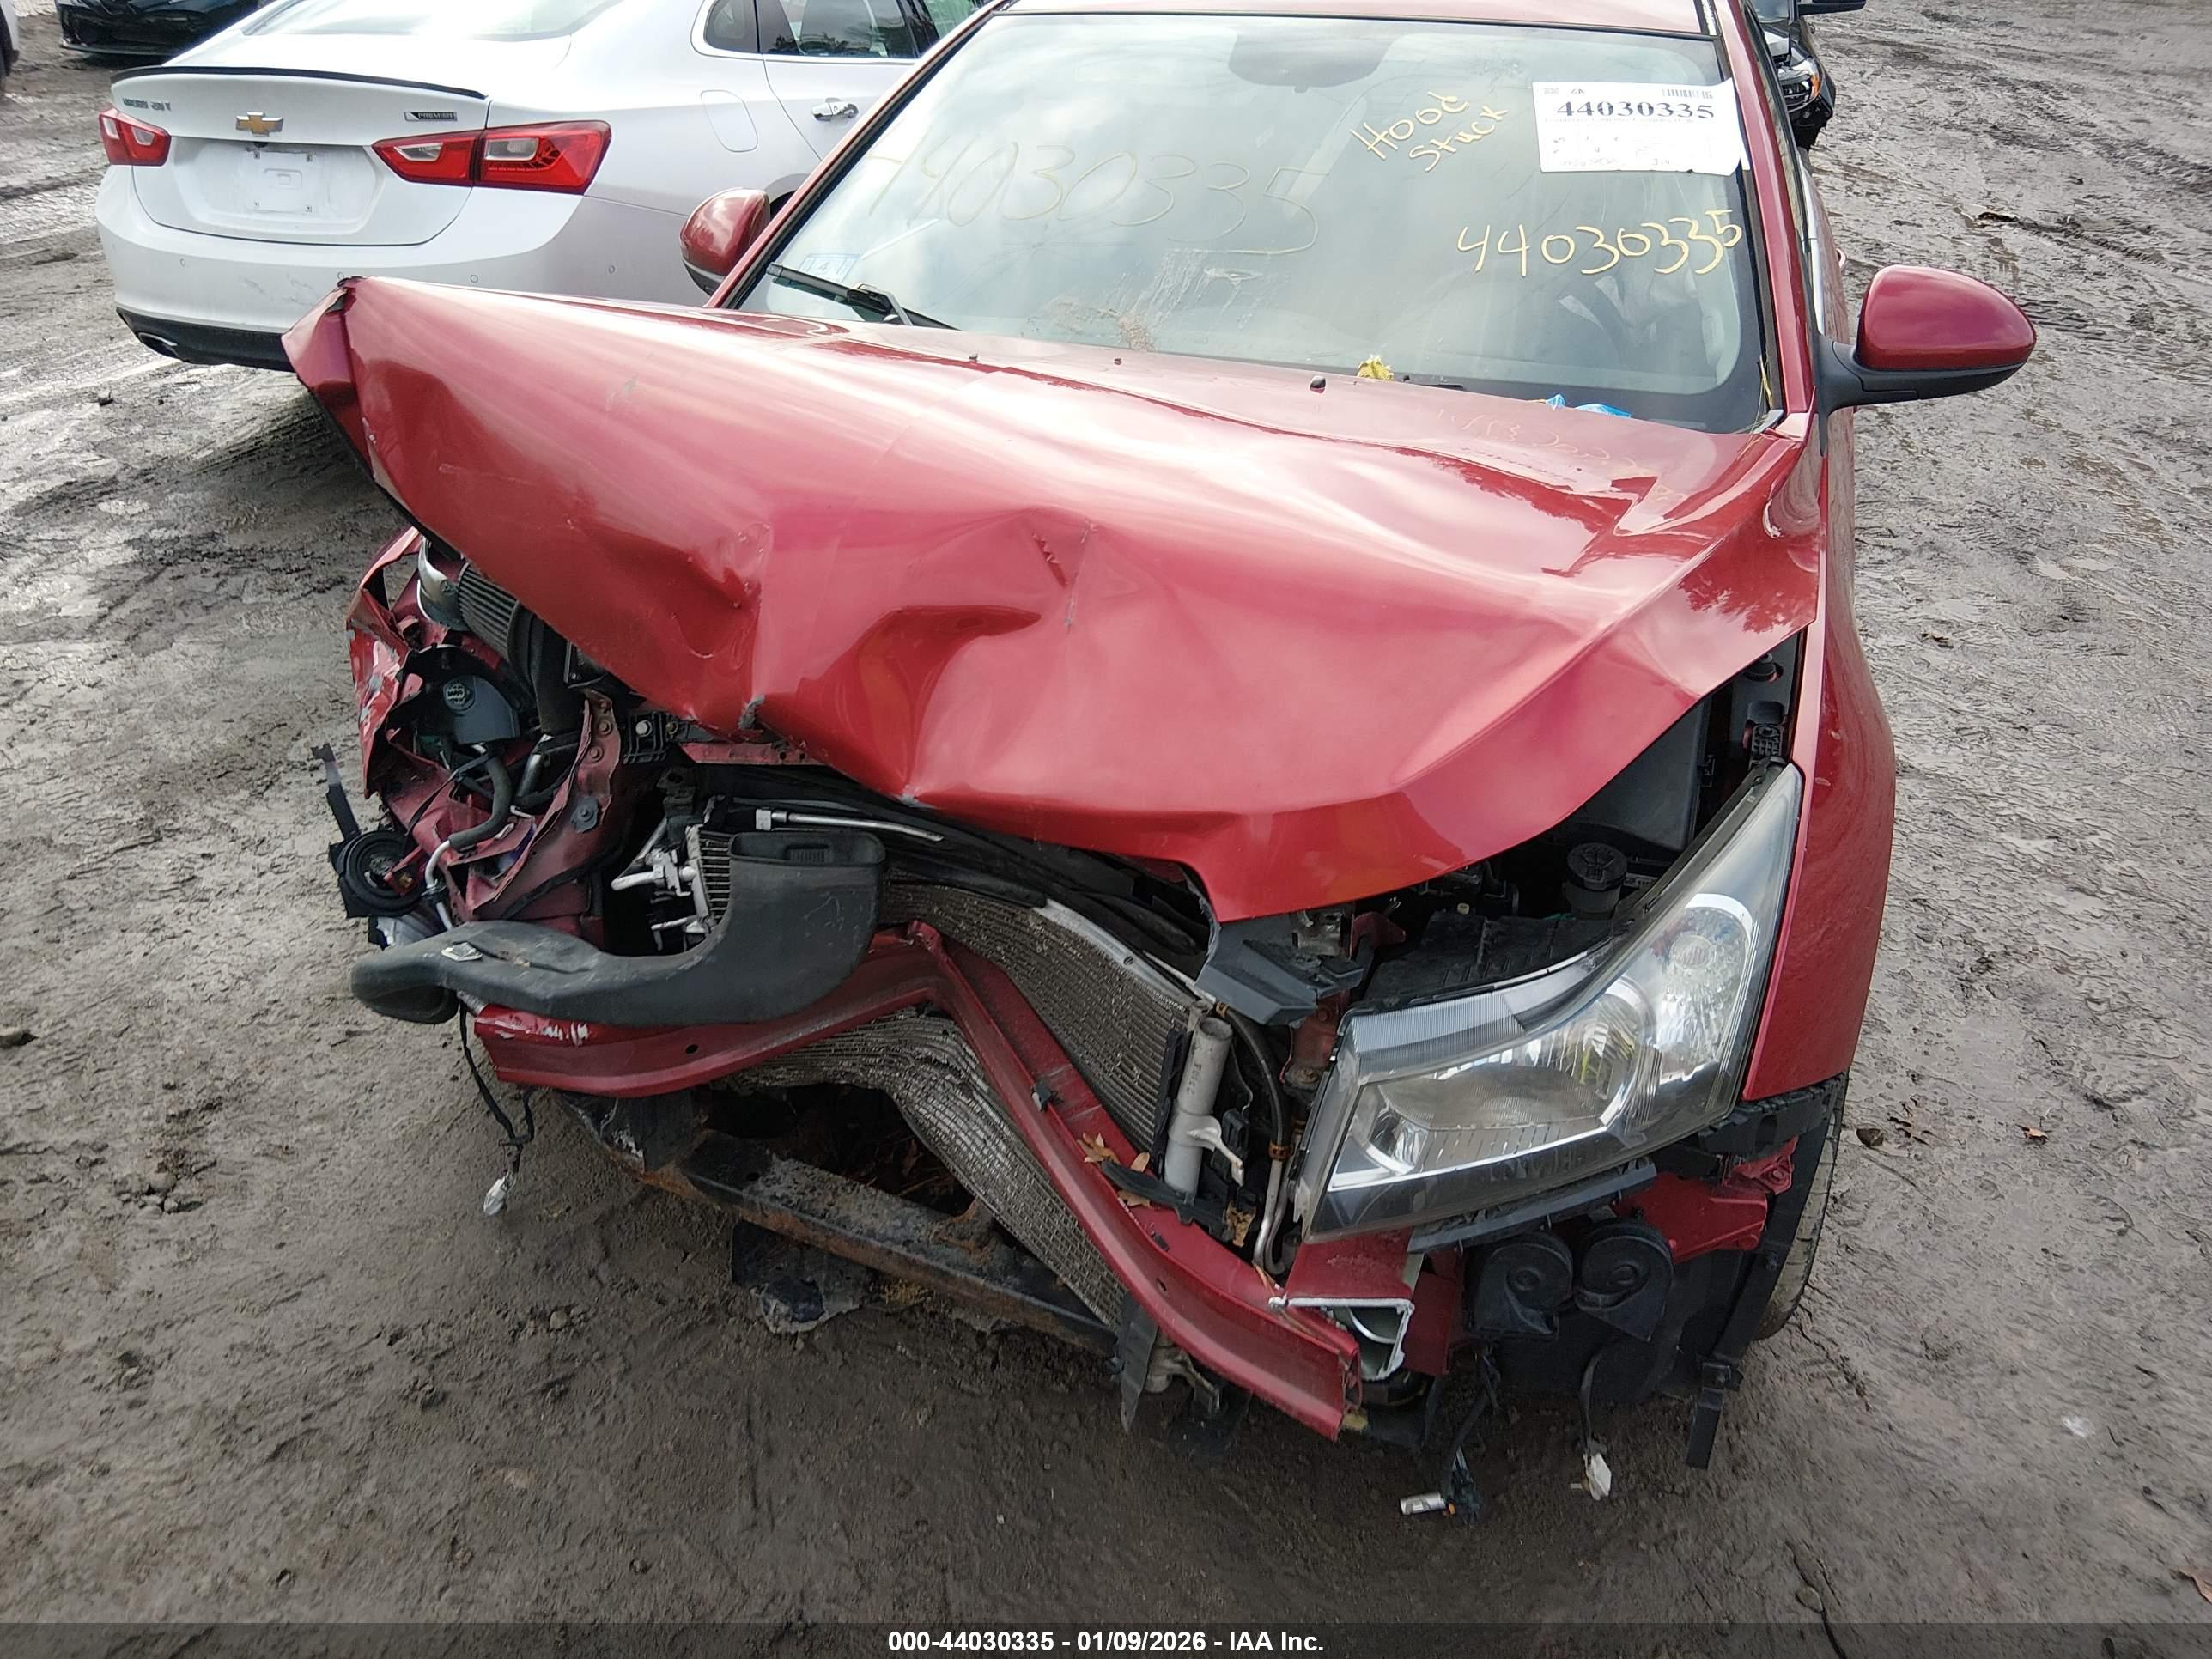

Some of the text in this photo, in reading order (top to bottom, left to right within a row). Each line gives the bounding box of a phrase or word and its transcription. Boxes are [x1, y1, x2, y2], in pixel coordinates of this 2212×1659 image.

[1350, 90, 1471, 161] Hood
[1556, 100, 1715, 119] 44030335
[1456, 209, 1743, 278] 44030335
